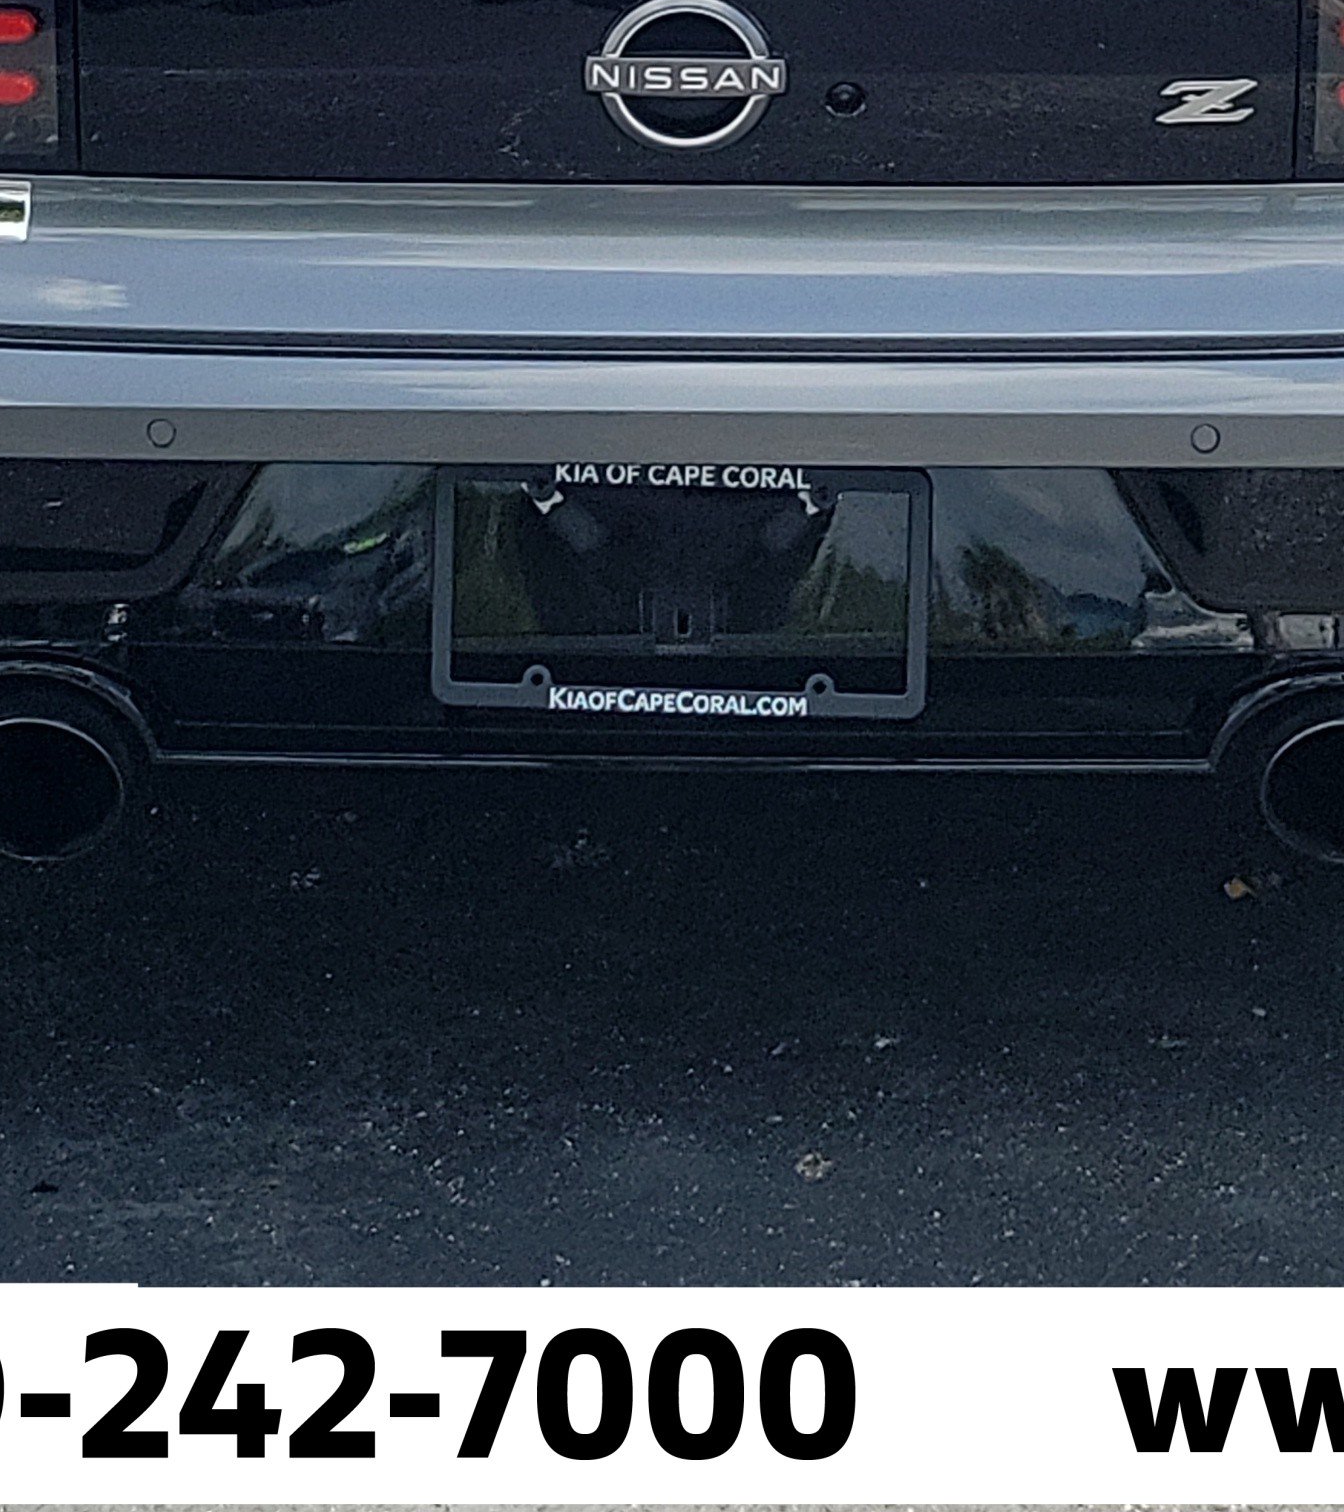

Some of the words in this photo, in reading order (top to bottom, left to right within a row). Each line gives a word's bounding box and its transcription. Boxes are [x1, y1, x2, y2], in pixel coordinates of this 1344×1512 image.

[591, 63, 781, 91] NISSAN
[1155, 78, 1258, 124] Z
[555, 463, 600, 484] KIA
[605, 464, 641, 485] OF
[647, 465, 716, 487] CAPE
[721, 466, 811, 490] CORAL
